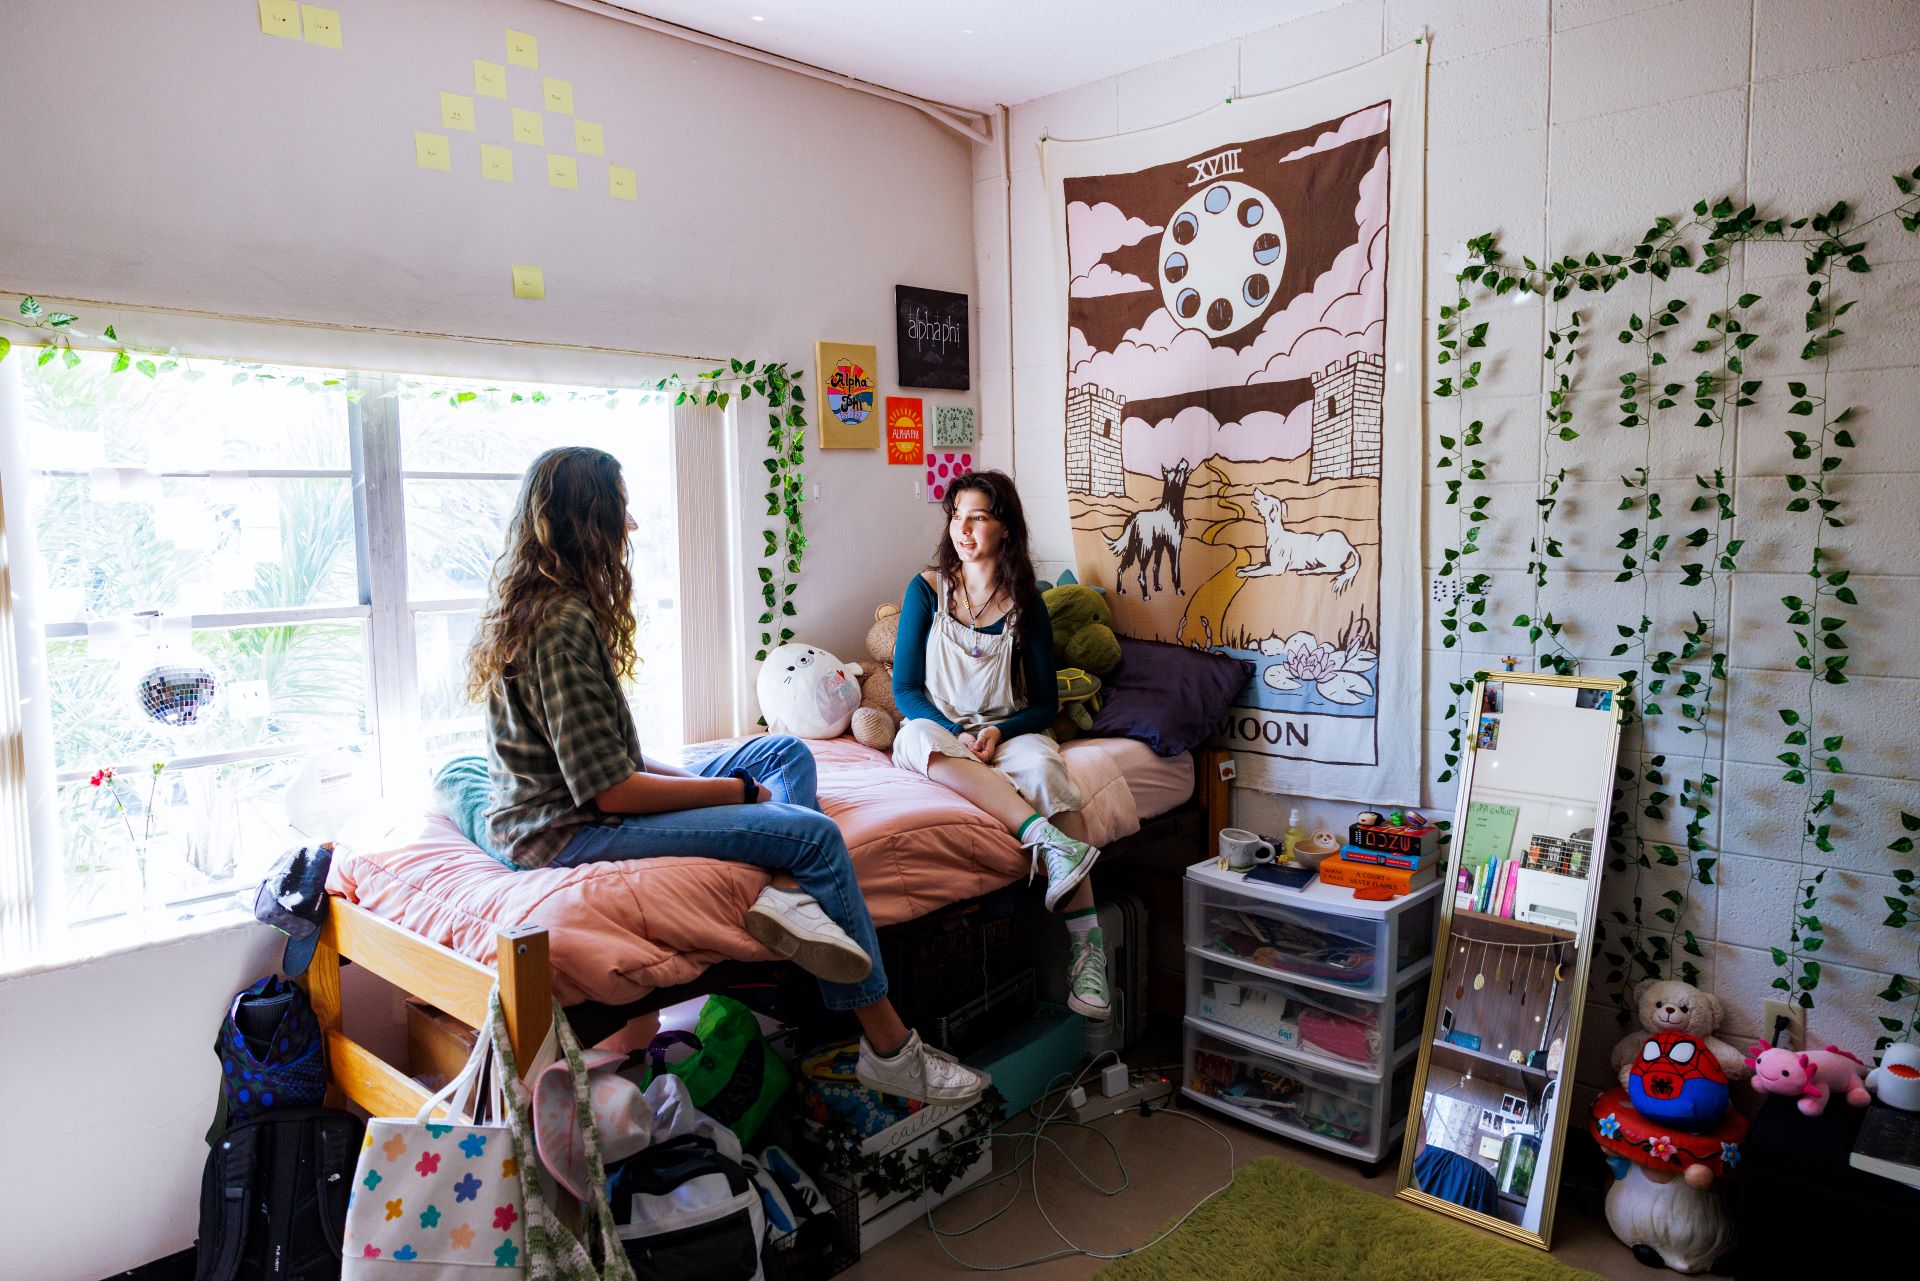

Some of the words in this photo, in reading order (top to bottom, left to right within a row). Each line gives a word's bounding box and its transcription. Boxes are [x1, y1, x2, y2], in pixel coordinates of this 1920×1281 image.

[1186, 148, 1244, 187] XVIII
[831, 372, 868, 393] Alpha
[841, 394, 863, 412] Phi
[1217, 716, 1309, 747] MOON
[1349, 878, 1371, 887] SILVER
[1372, 881, 1398, 890] FLAMES
